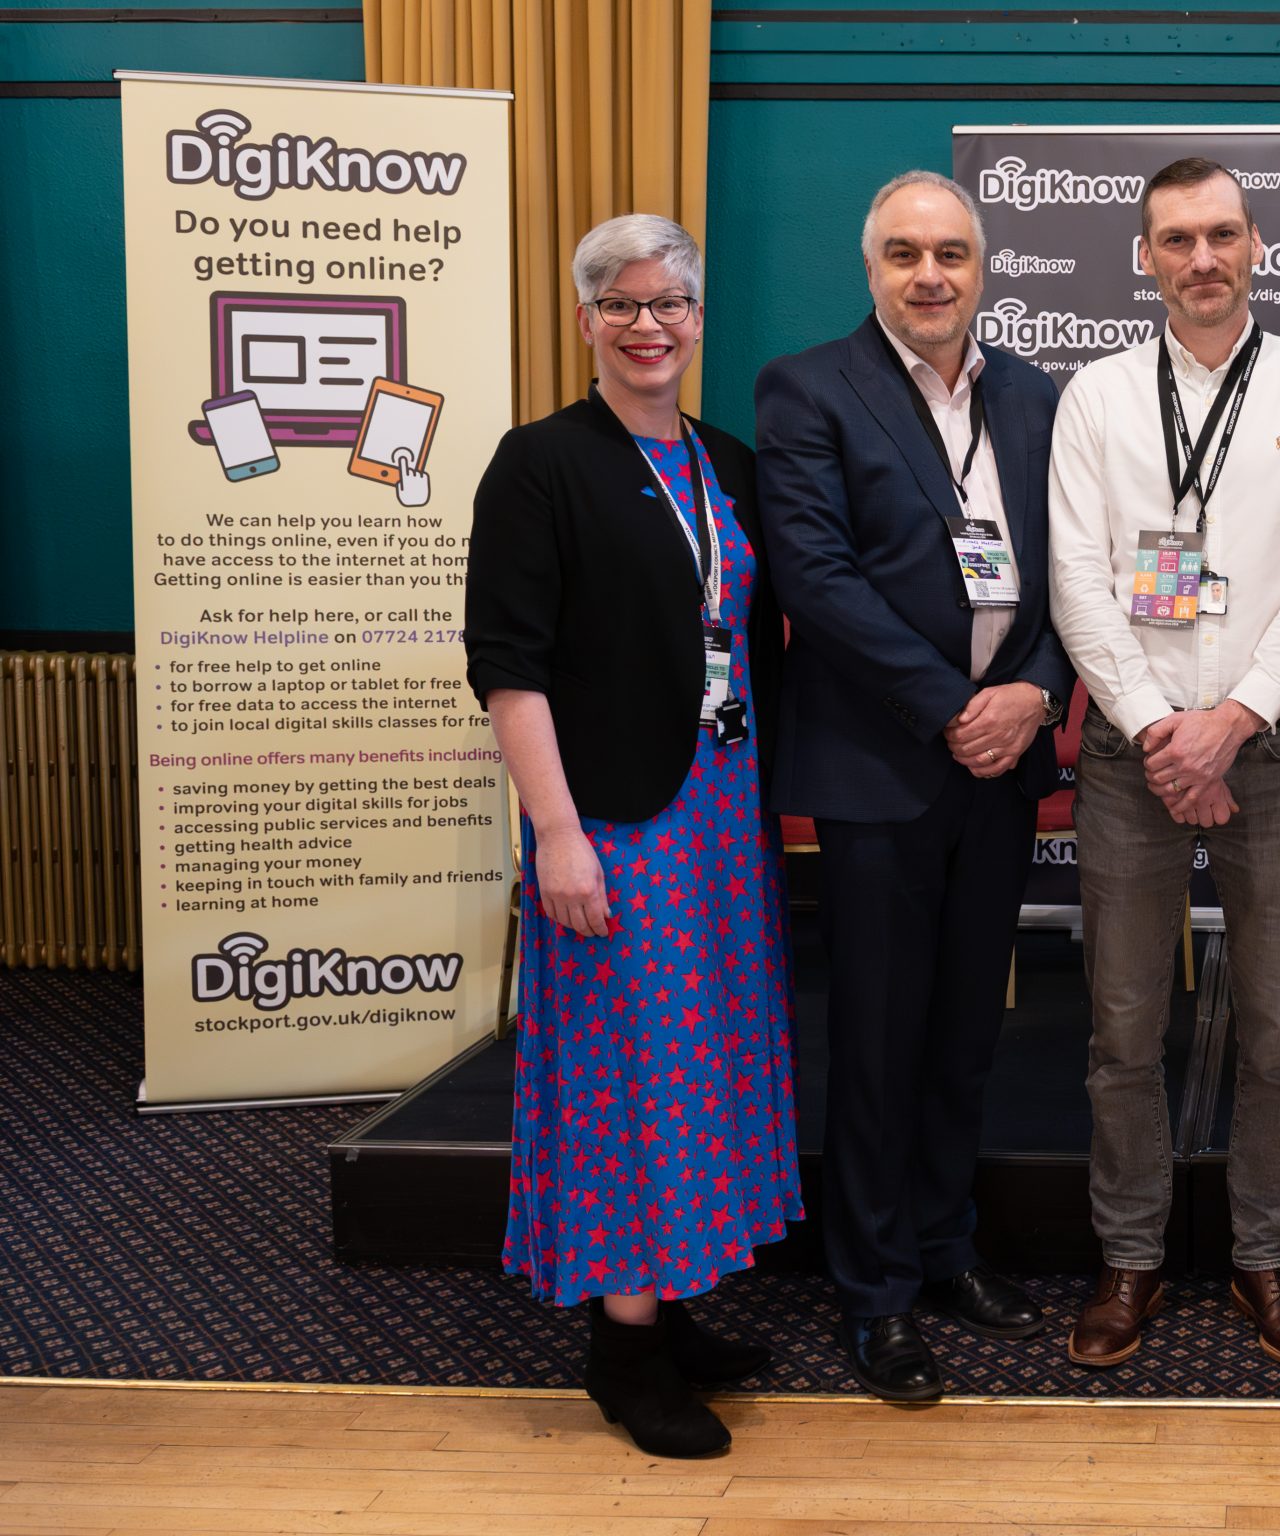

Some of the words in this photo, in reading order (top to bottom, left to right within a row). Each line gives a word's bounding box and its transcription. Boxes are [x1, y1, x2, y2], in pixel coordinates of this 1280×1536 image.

[165, 129, 467, 201] DigiKnow
[980, 168, 1145, 211] DigiKnow
[175, 209, 220, 236] Do
[228, 217, 290, 243] you
[302, 217, 382, 242] need
[393, 218, 462, 250] help
[193, 251, 315, 285] getting
[326, 255, 445, 282] online?
[991, 255, 1075, 277] DigiKnow
[977, 311, 1153, 356] DigiKnow
[205, 513, 235, 527] We
[239, 516, 272, 527] can
[277, 513, 316, 531] help
[320, 517, 353, 531] you
[358, 514, 402, 528] learn
[407, 514, 443, 528] how
[156, 533, 176, 547] to
[180, 533, 204, 547] do
[208, 532, 267, 551] things
[271, 533, 332, 550] online,
[336, 536, 378, 547] even
[383, 533, 396, 547] if
[397, 536, 429, 551] you
[434, 534, 456, 548] do
[163, 552, 206, 567] have
[211, 555, 274, 567] access
[278, 553, 297, 567] to
[301, 553, 331, 567] the
[336, 553, 406, 567] internet
[409, 553, 428, 567] at
[153, 572, 222, 590] Getting
[226, 572, 283, 586] online
[288, 572, 303, 586] is
[307, 572, 362, 586] easier
[365, 572, 405, 586] than
[409, 575, 441, 589] you
[199, 608, 233, 623] Ask
[237, 608, 265, 623] for
[269, 608, 309, 626] help
[314, 608, 359, 625] here,
[364, 611, 384, 622] or
[387, 608, 418, 622] call
[422, 608, 453, 622] the
[160, 630, 248, 649] DigiKnow
[254, 630, 329, 648] Helpline
[334, 633, 357, 644] on
[362, 630, 418, 644] 07724
[169, 660, 194, 674] for
[197, 660, 231, 673] free
[235, 659, 272, 676] help
[276, 660, 294, 673] to
[298, 659, 326, 676] get
[330, 658, 381, 672] online
[169, 680, 188, 693] to
[192, 679, 253, 693] borrow
[257, 681, 267, 692] a
[272, 679, 326, 695] laptop
[330, 680, 348, 691] or
[350, 677, 400, 691] tablet
[403, 677, 427, 690] for
[429, 677, 462, 690] free
[170, 699, 195, 713] for
[198, 699, 232, 712] free
[236, 698, 274, 712] data
[278, 698, 296, 711] to
[300, 699, 358, 711] access
[361, 697, 389, 710] the
[393, 696, 458, 709] internet
[170, 719, 189, 732] to
[191, 718, 225, 735] join
[229, 717, 270, 731] local
[274, 716, 327, 734] digital
[332, 715, 374, 730] skills
[377, 715, 438, 729] classes
[441, 715, 465, 728] for
[468, 714, 491, 727] fre
[149, 753, 197, 770] Being
[200, 752, 253, 767] online
[257, 751, 306, 765] offers
[309, 753, 356, 766] many
[358, 749, 425, 763] benefits
[172, 781, 228, 798] saving
[233, 782, 291, 796] money
[295, 779, 315, 795] by
[318, 778, 378, 795] getting
[381, 777, 409, 791] the
[413, 777, 449, 790] best
[452, 775, 496, 789] deals
[173, 801, 259, 818] improving
[263, 801, 302, 816] your
[305, 797, 357, 814] digital
[361, 796, 403, 810] skills
[406, 796, 430, 809] for
[431, 795, 468, 812] jobs
[174, 819, 259, 836] accessing
[263, 817, 316, 835] public
[319, 816, 388, 830] services
[392, 815, 422, 828] and
[427, 813, 493, 828] benefits
[174, 839, 236, 857] getting
[240, 837, 293, 852] health
[298, 835, 353, 850] advice
[175, 860, 260, 875] managing
[263, 859, 302, 873] your
[305, 857, 362, 870] money
[175, 877, 243, 895] keeping
[247, 876, 263, 890] in
[266, 875, 315, 889] touch
[319, 873, 354, 887] with
[358, 872, 409, 888] family
[412, 871, 442, 885] and
[446, 869, 504, 884] friends
[176, 897, 246, 913] learning
[250, 896, 268, 909] at
[271, 895, 319, 908] home
[192, 948, 464, 1011] DigiKnow
[194, 1007, 456, 1034] stockport.gov.uk/digiknow
